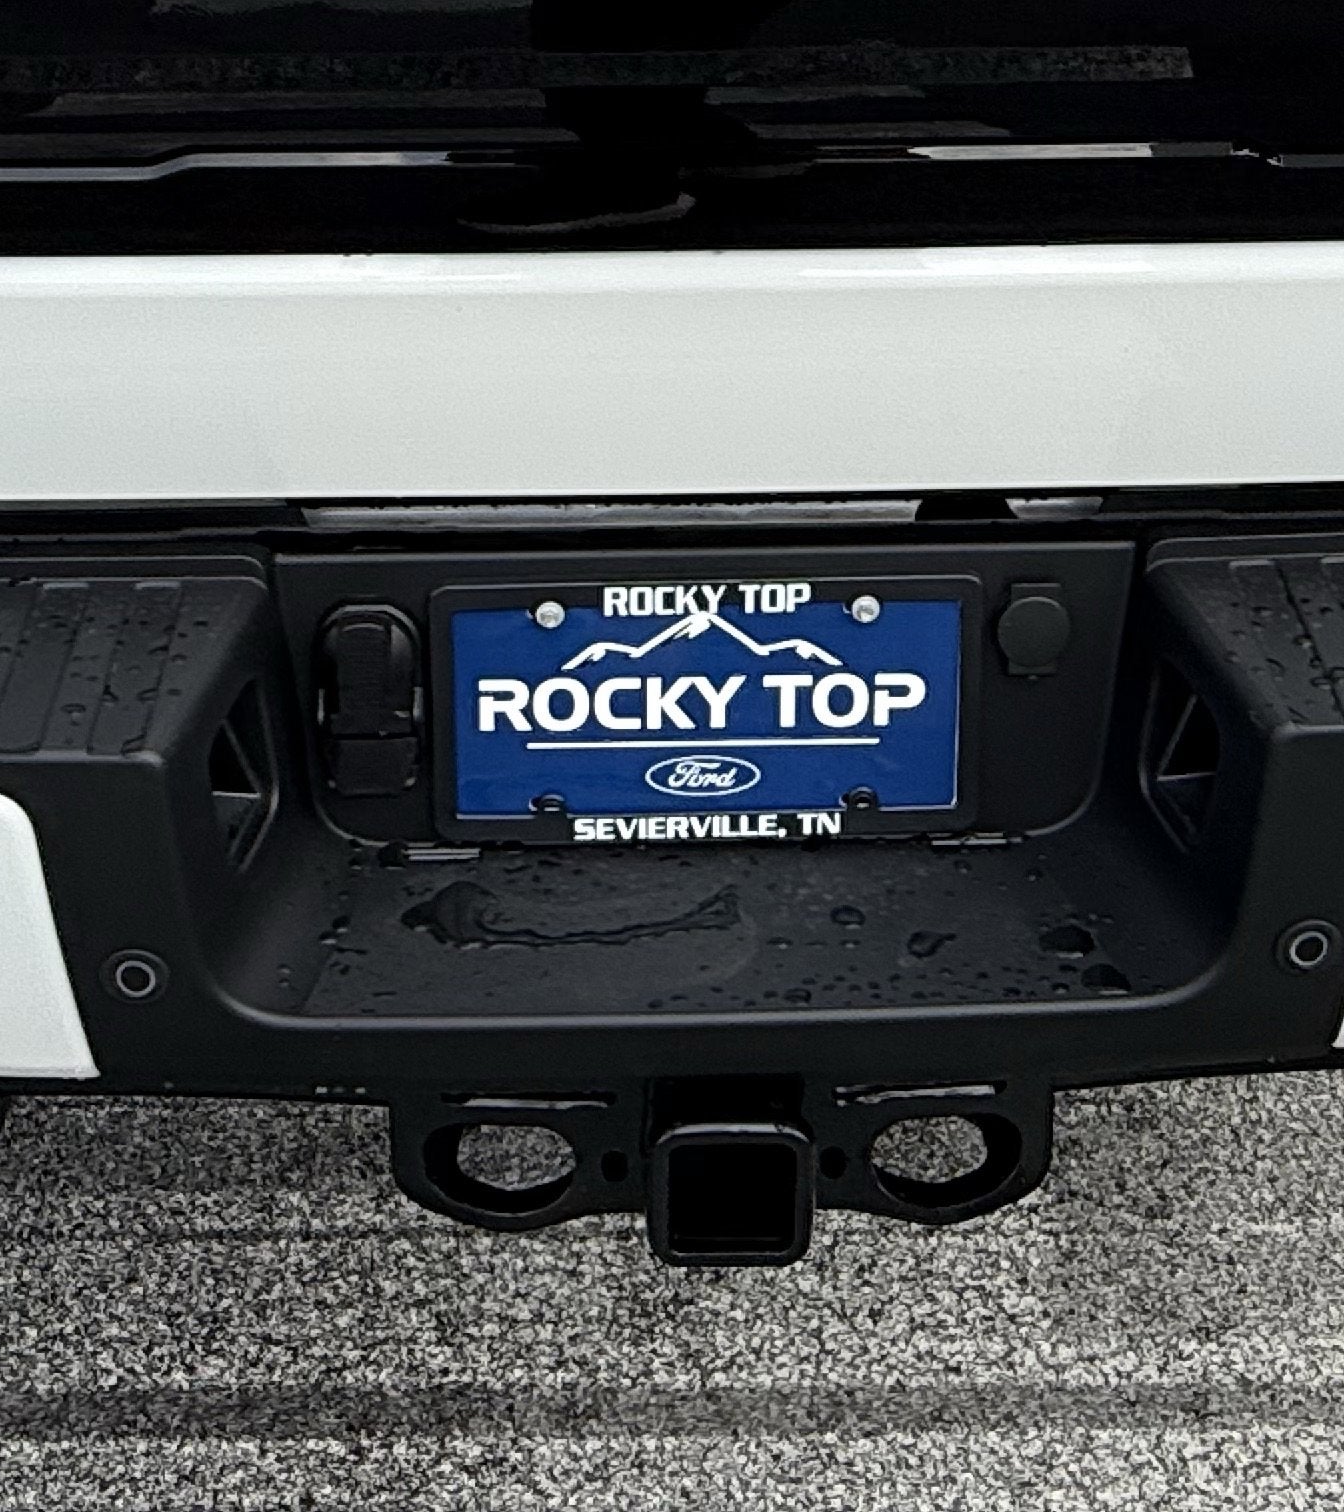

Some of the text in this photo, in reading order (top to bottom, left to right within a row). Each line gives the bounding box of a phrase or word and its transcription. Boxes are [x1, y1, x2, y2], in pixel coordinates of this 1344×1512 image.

[603, 582, 811, 617] ROCKY TOP
[478, 672, 927, 732] ROCKY TOP
[667, 761, 737, 789] Ford
[573, 812, 842, 841] SEVIERVILLE, TN
